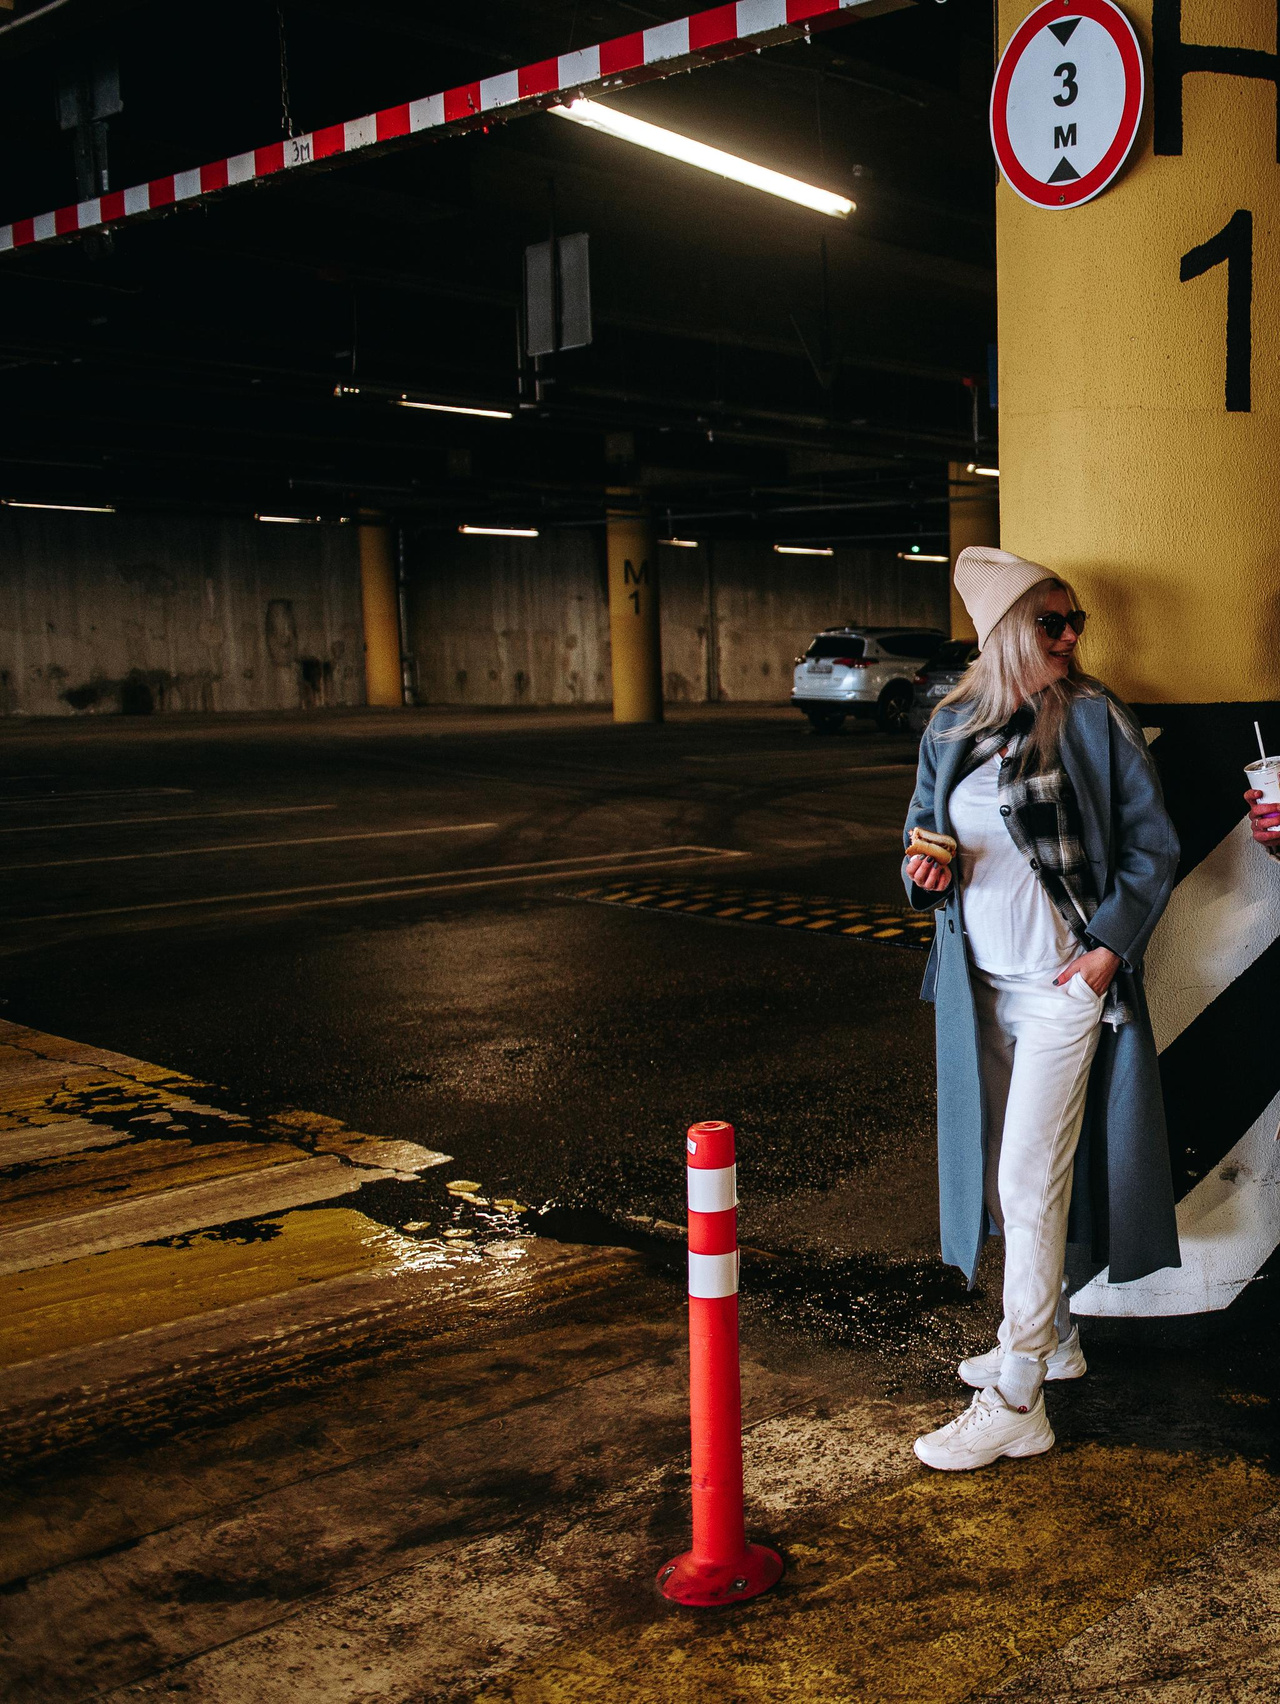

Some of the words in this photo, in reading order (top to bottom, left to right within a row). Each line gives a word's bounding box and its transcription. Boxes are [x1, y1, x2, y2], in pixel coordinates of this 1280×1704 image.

[1052, 62, 1079, 107] 3
[1180, 209, 1253, 413] 1
[628, 590, 640, 615] 1
